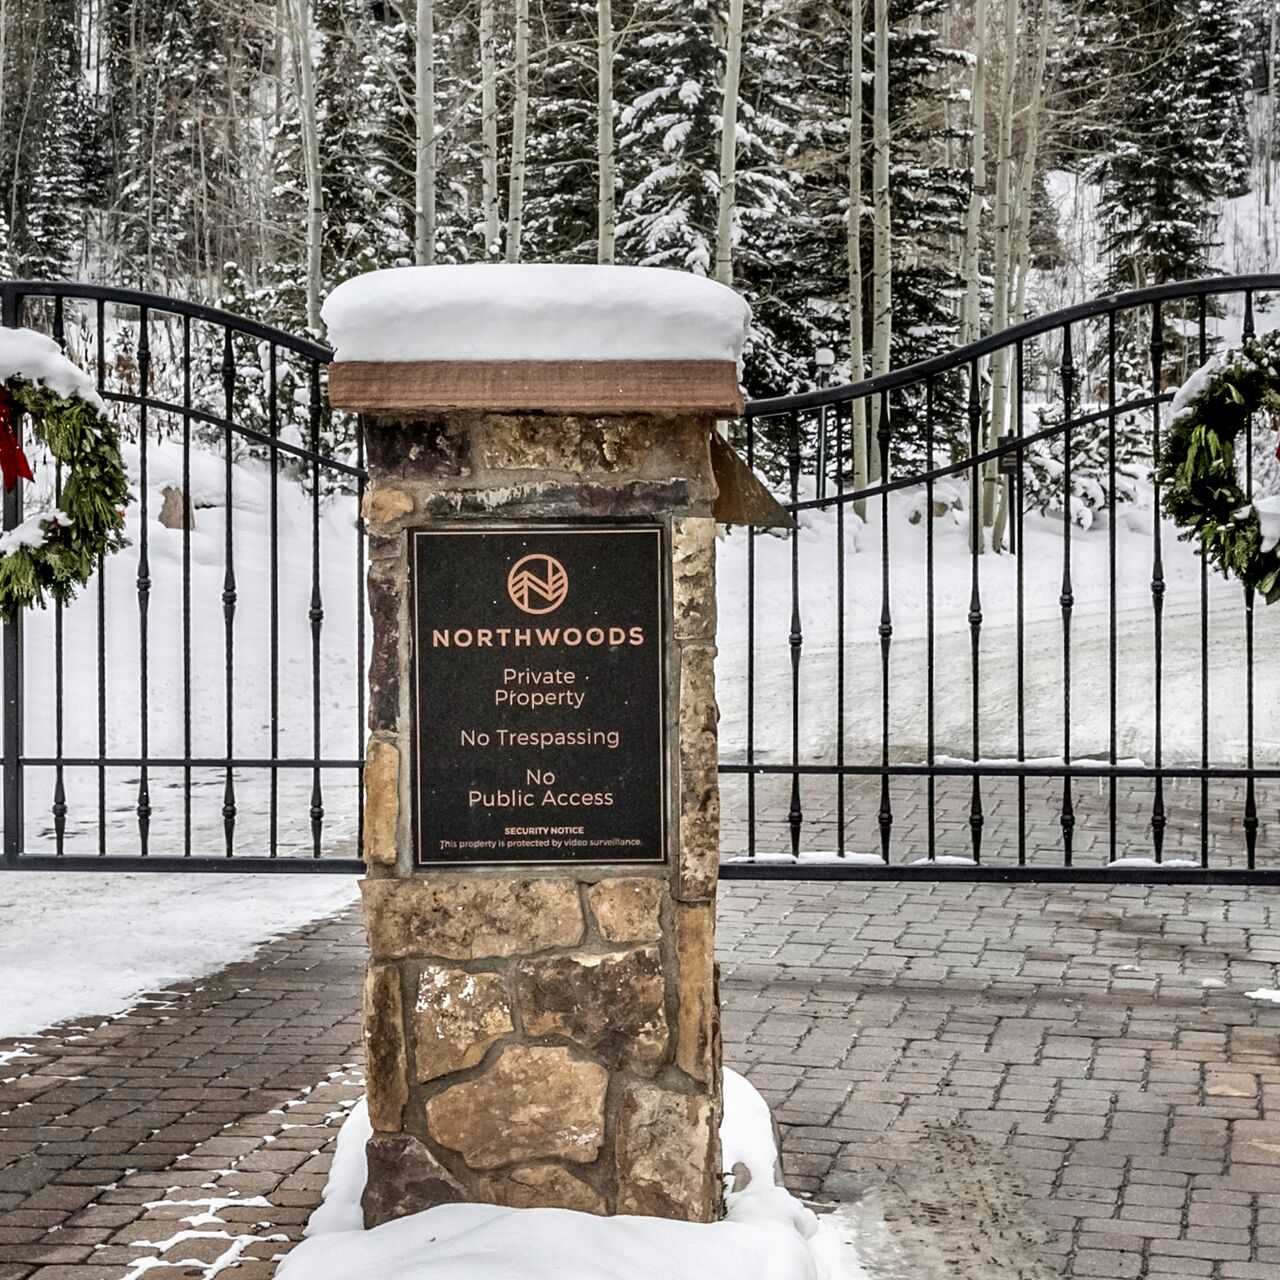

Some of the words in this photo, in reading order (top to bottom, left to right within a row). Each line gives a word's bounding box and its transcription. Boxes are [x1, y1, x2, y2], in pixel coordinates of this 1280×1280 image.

[433, 626, 645, 647] NORTHWOODS
[503, 668, 576, 685] Private
[495, 689, 585, 709] Property
[460, 729, 490, 747] No
[496, 728, 620, 749] Trespassing
[526, 768, 556, 786] No
[468, 790, 535, 808] Public
[541, 789, 614, 807] Access
[504, 827, 549, 836] SECURITY
[550, 826, 585, 835] NOTICE
[439, 840, 457, 849] This
[459, 839, 497, 849] property
[498, 839, 506, 847] is
[507, 839, 550, 849] protected
[551, 838, 564, 849] by
[564, 838, 588, 847] video
